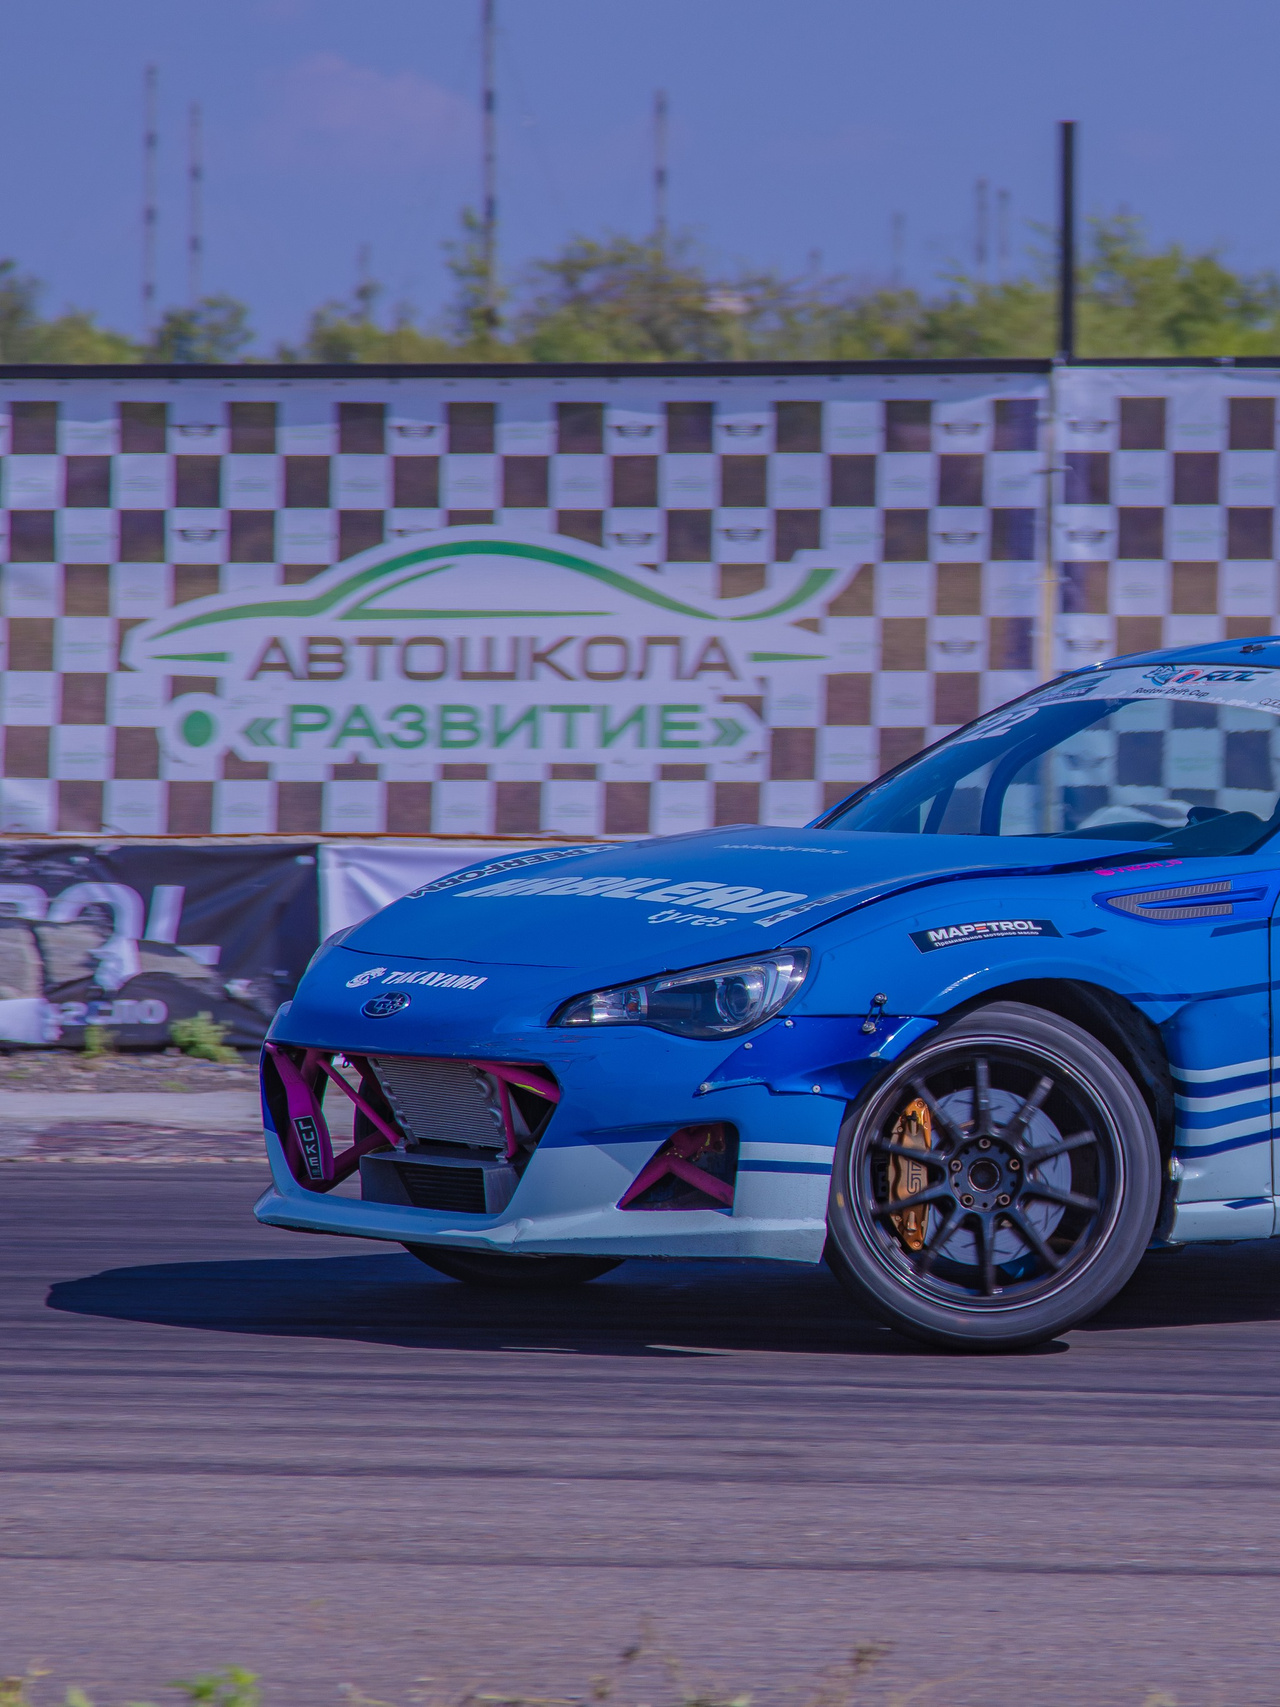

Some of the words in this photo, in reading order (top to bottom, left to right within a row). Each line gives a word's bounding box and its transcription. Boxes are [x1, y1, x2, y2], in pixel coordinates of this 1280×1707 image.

[248, 635, 743, 681] АВТОШКОЛА
[1189, 689, 1209, 698] Cup
[242, 704, 749, 749] «РАЗВИТИЕ»
[452, 876, 808, 914] HABILEAD
[648, 909, 738, 927] tyres
[929, 921, 1042, 942] MAPETROL
[934, 934, 982, 947] Премиальное
[381, 970, 489, 990] TAKAYAMA
[298, 1120, 320, 1167] LUKE
